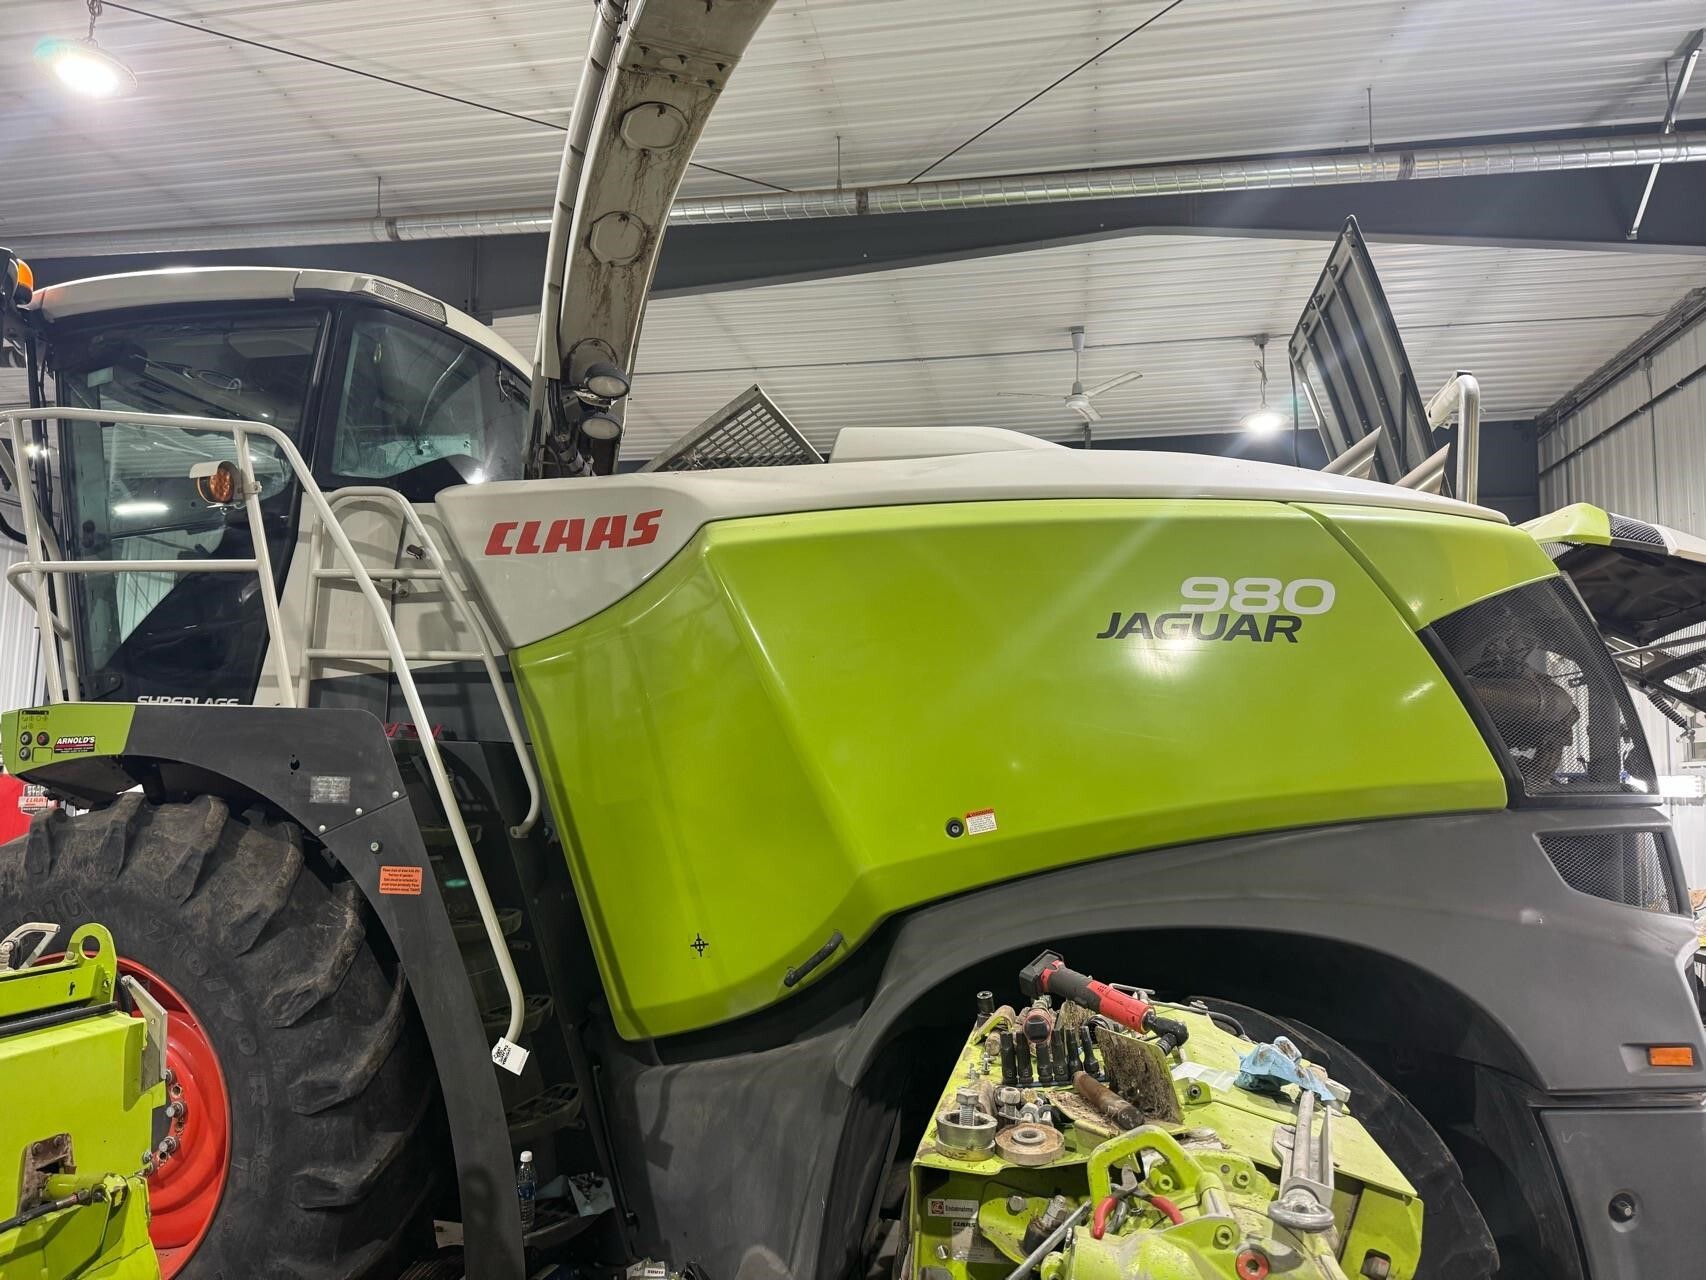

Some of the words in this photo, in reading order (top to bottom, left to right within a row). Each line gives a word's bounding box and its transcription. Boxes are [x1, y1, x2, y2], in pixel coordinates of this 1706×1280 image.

[485, 509, 664, 556] CLAAS
[1179, 576, 1336, 615] 980
[1096, 612, 1303, 643] JAGUAR
[56, 736, 95, 745] ARNOLD'S
